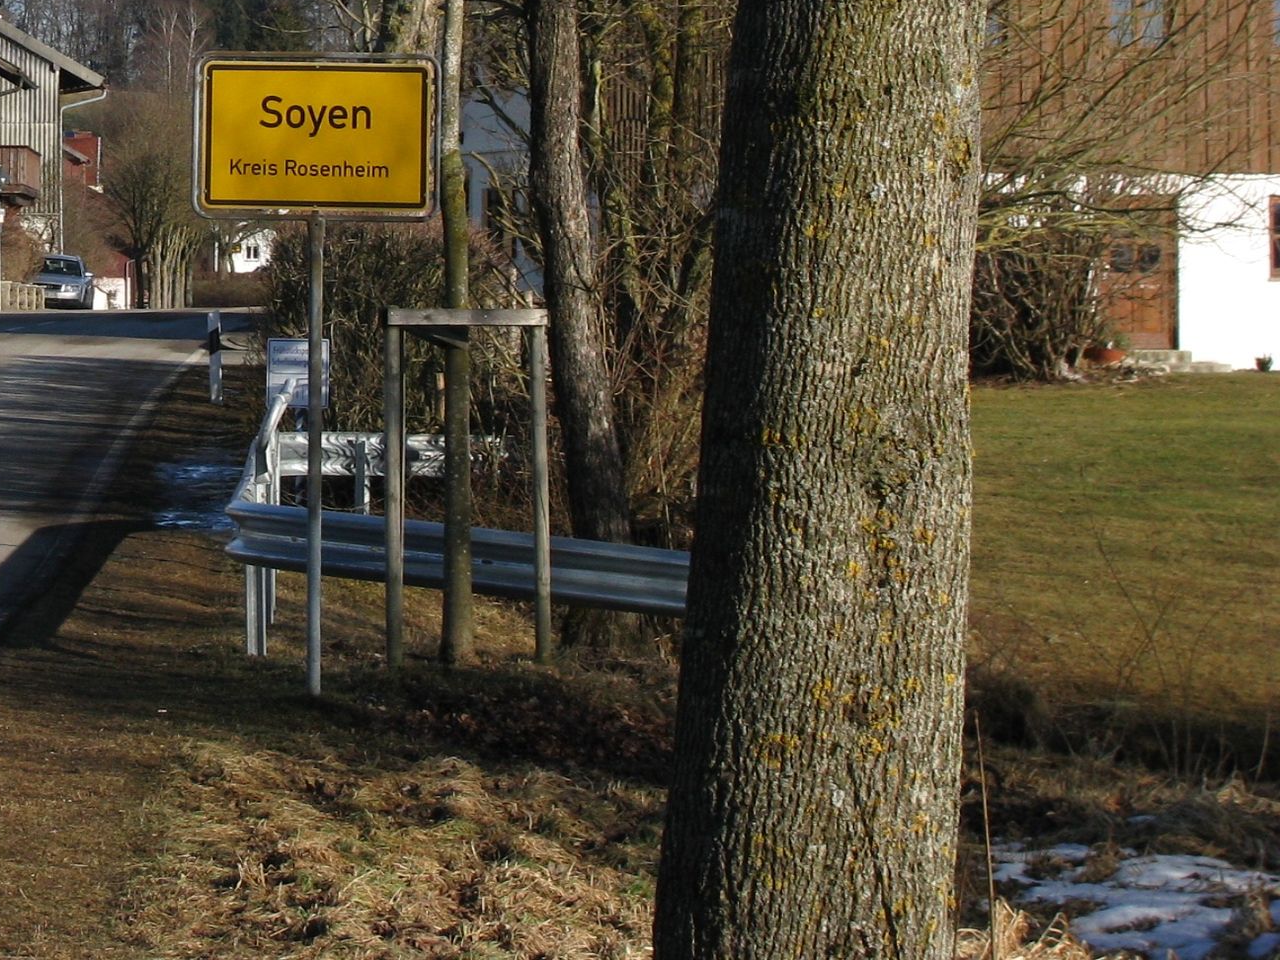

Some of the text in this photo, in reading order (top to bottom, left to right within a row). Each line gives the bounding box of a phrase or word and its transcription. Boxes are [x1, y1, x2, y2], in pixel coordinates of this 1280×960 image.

[259, 95, 372, 138] Soyen
[229, 158, 390, 178] Kreis Rosenheim
